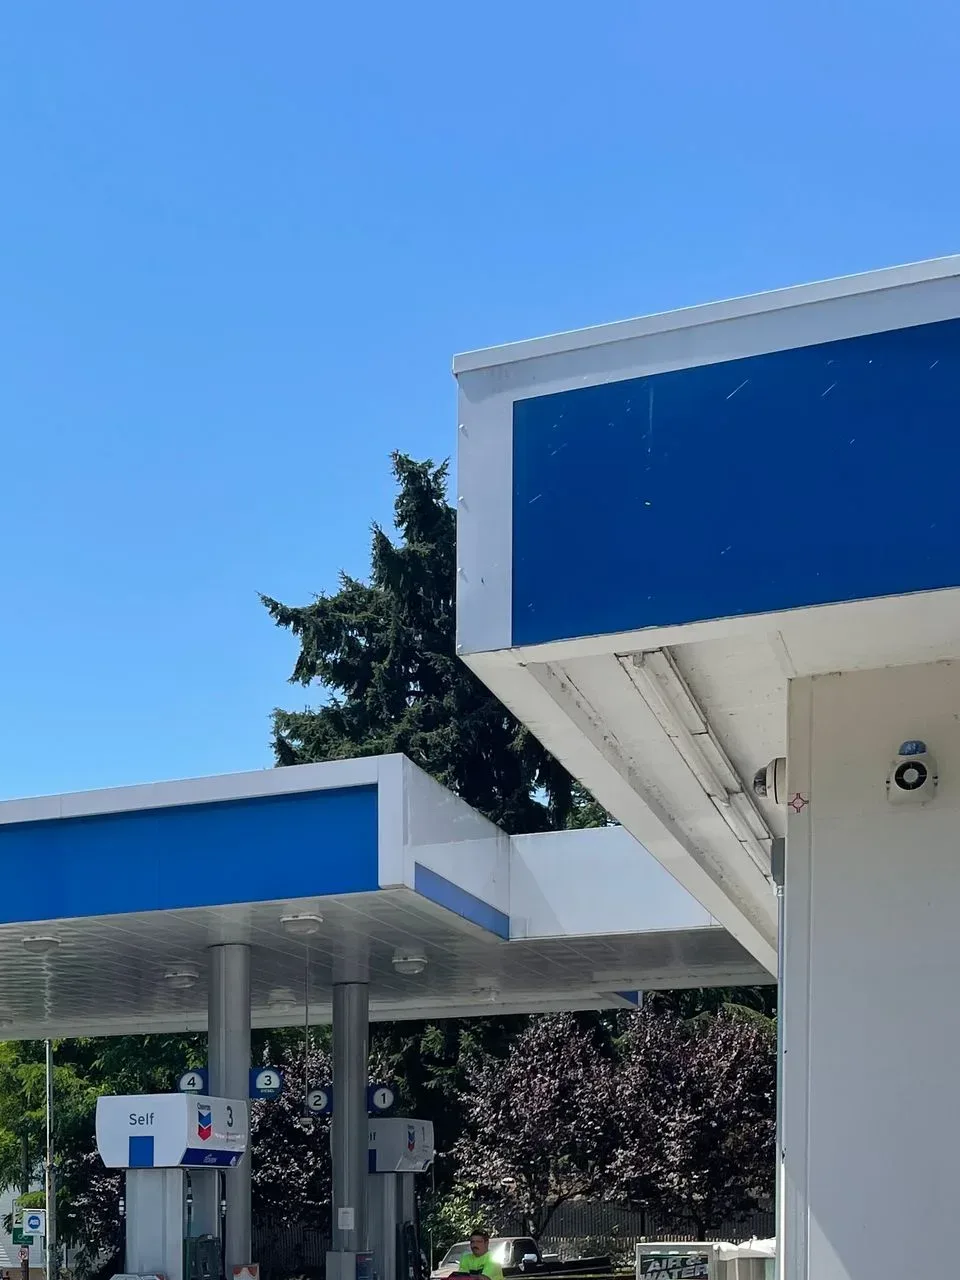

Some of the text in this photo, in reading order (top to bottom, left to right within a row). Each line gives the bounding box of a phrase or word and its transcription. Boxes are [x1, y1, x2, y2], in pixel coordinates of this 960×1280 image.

[187, 1076, 195, 1087] 4
[264, 1075, 272, 1086] 3
[313, 1094, 322, 1106] 2
[381, 1092, 386, 1104] 1
[128, 1112, 155, 1126] Self
[226, 1105, 234, 1127] 3
[646, 1253, 702, 1273] AIR &
